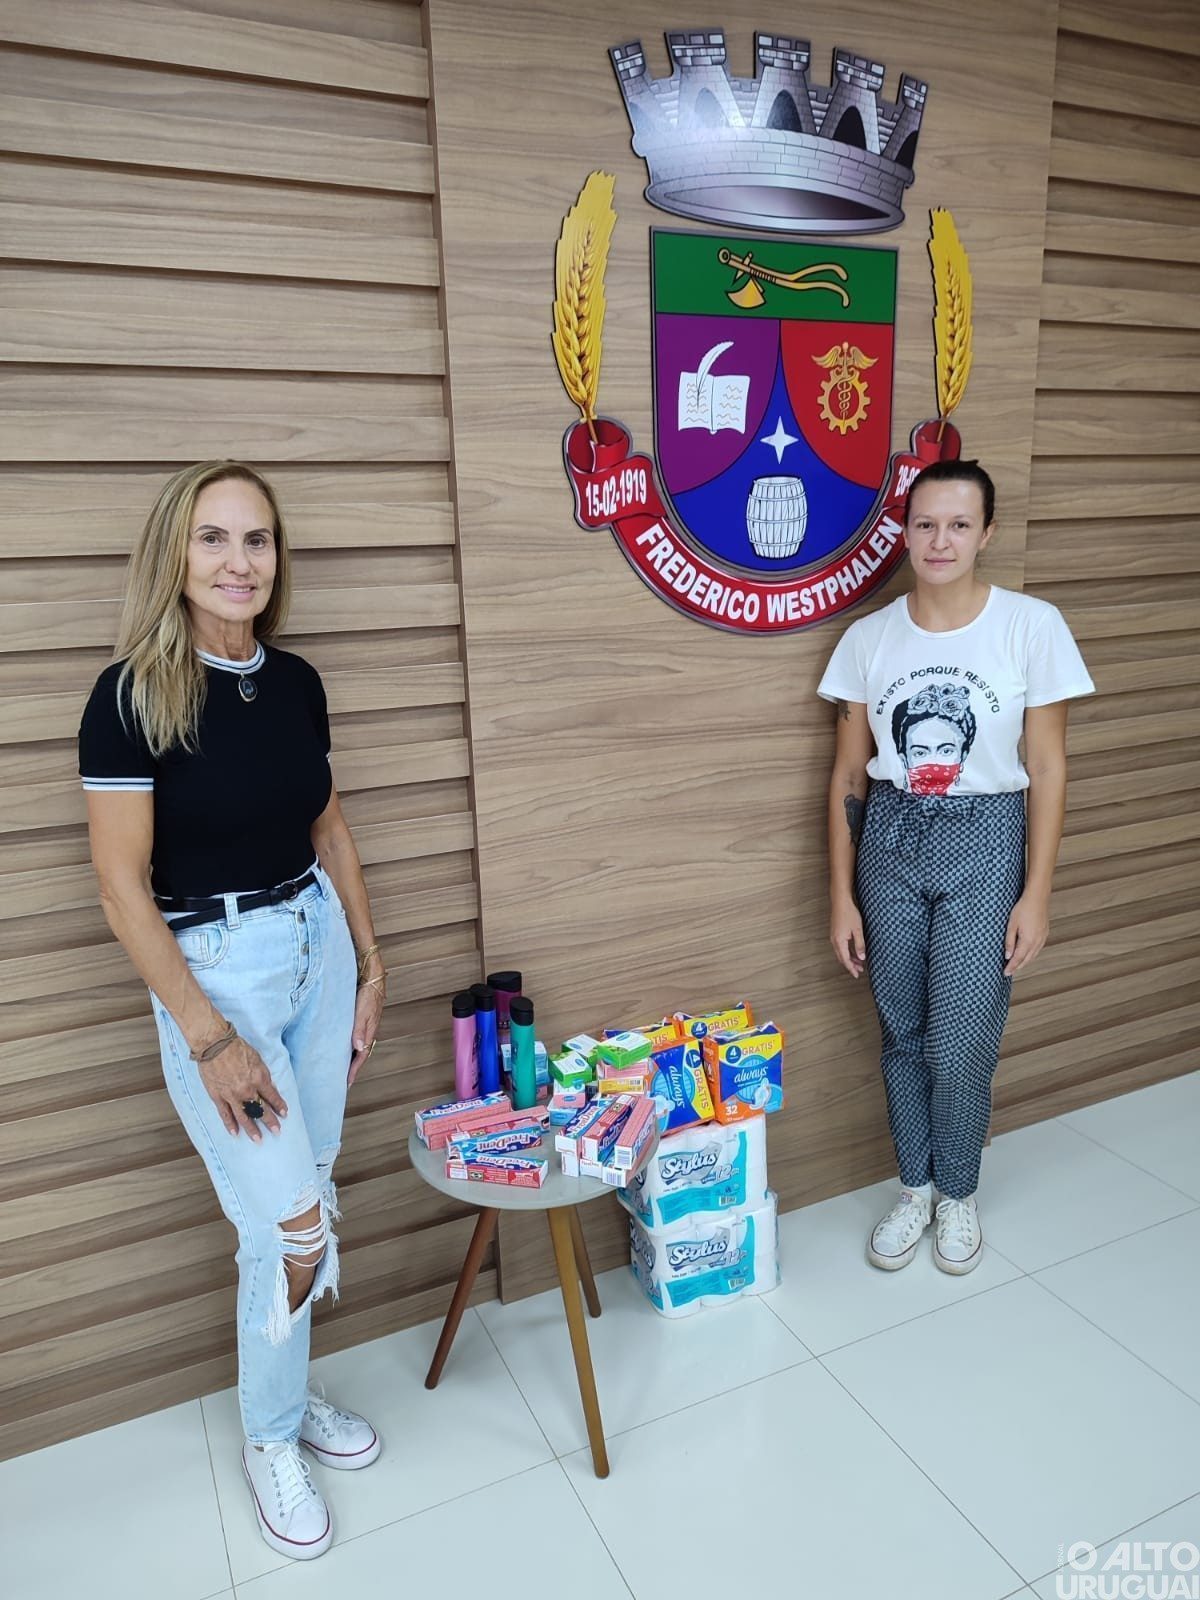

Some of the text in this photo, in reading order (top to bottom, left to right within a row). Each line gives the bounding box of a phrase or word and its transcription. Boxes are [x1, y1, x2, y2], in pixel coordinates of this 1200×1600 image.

[585, 468, 647, 517] 15-02-1919
[636, 517, 903, 623] FREDERICO WESTPHALEN
[876, 666, 1000, 715] EXISTO PORQUE RESISTO
[708, 1017, 739, 1032] GRATIS
[743, 1041, 774, 1056] GRATIS
[668, 1065, 685, 1109] always
[734, 1066, 769, 1084] always
[694, 1069, 709, 1110] GRATIS
[725, 1104, 738, 1116] 32
[477, 1132, 530, 1151] FreeDent
[661, 1151, 718, 1179] Stylus
[669, 1239, 728, 1266] Stylus
